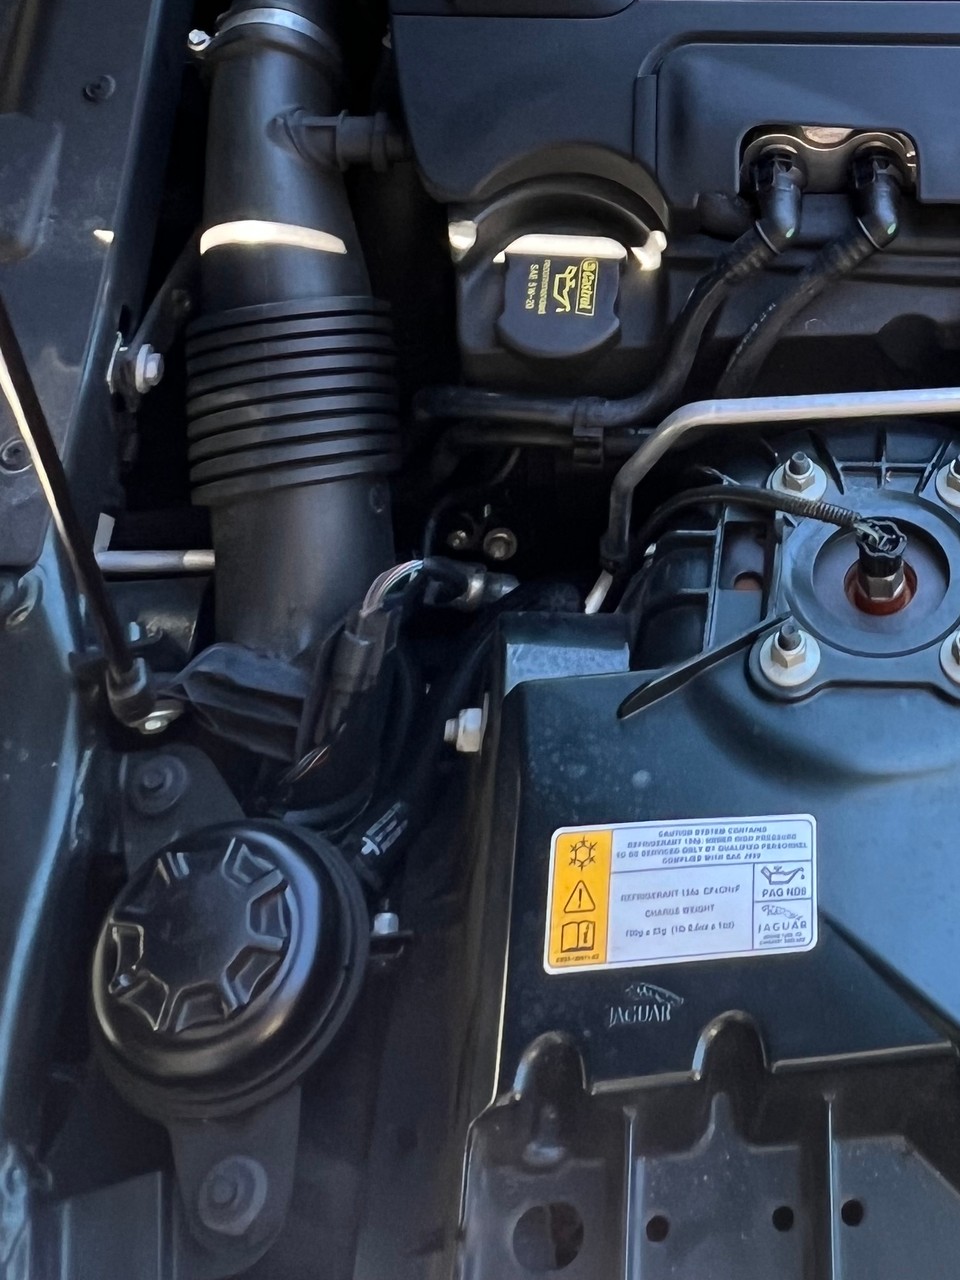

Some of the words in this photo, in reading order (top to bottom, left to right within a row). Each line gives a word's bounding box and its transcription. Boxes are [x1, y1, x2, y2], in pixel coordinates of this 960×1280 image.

[528, 264, 539, 279] SAE
[579, 271, 595, 309] Castrol
[761, 888, 784, 898] PAG
[758, 920, 807, 934] JAGUAR
[608, 1003, 671, 1028] JAGUAR
